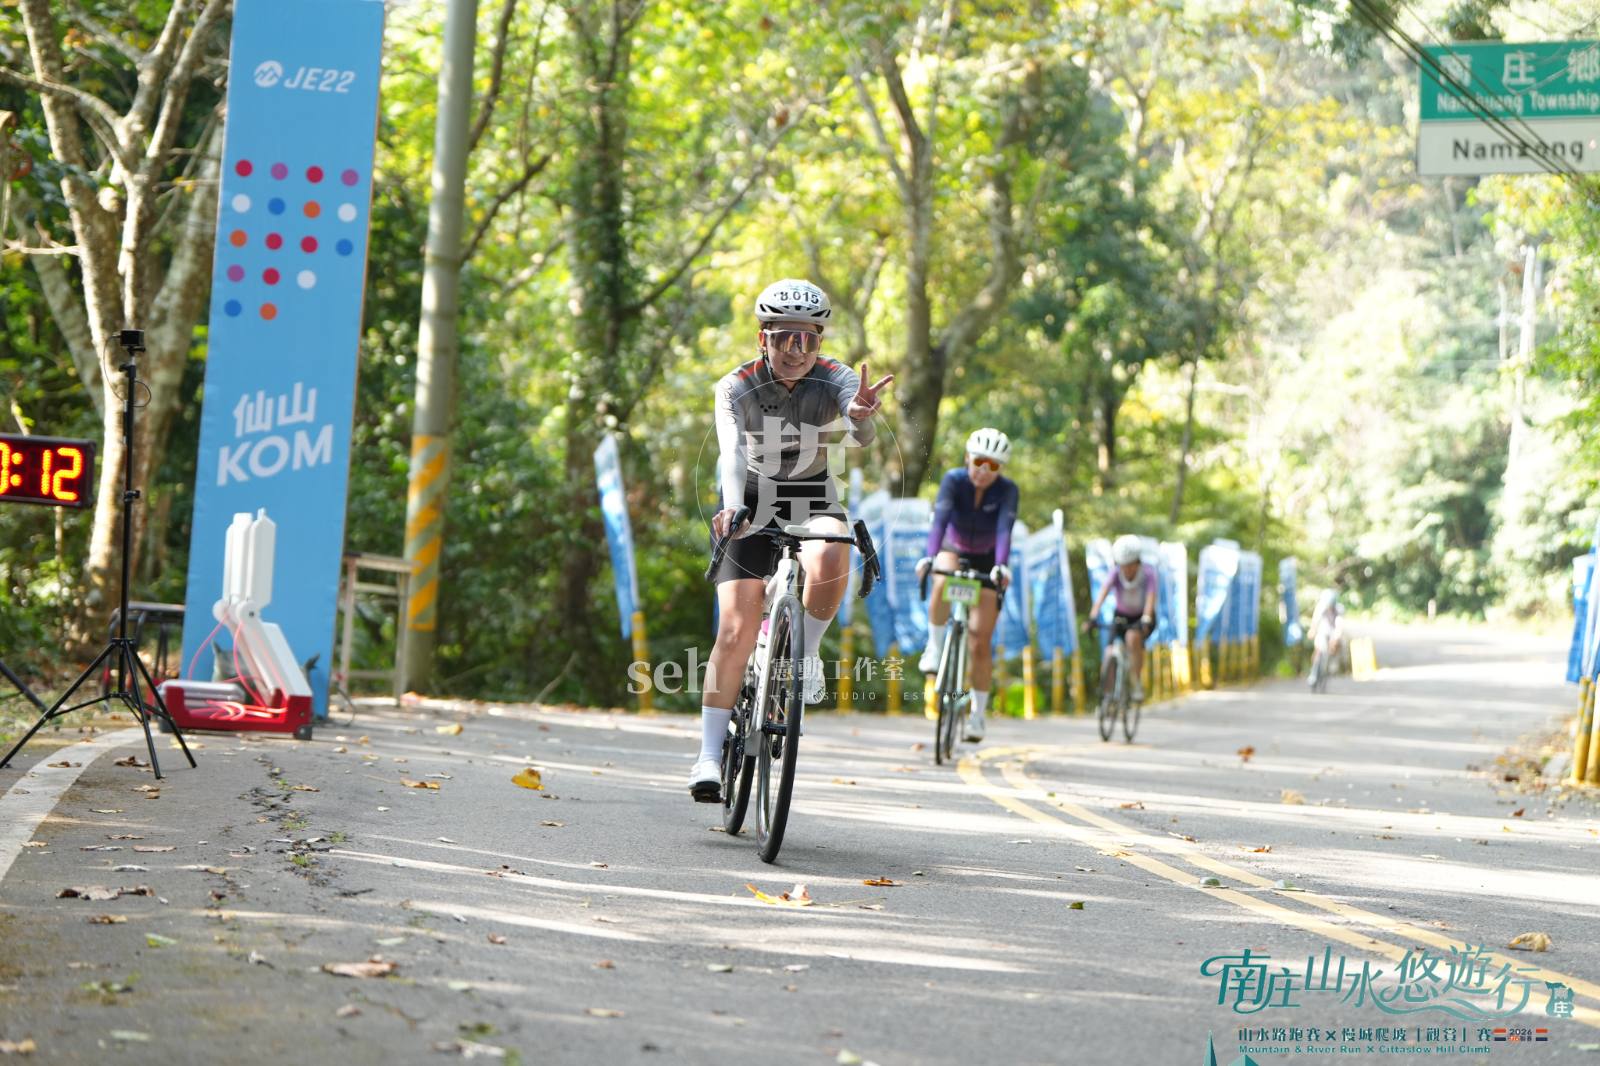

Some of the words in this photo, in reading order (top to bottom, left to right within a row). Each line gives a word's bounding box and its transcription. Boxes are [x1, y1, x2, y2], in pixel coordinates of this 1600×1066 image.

[284, 66, 355, 93] JE22
[1530, 90, 1599, 112] Township
[232, 381, 317, 439] 仙山
[216, 424, 333, 487] KOM
